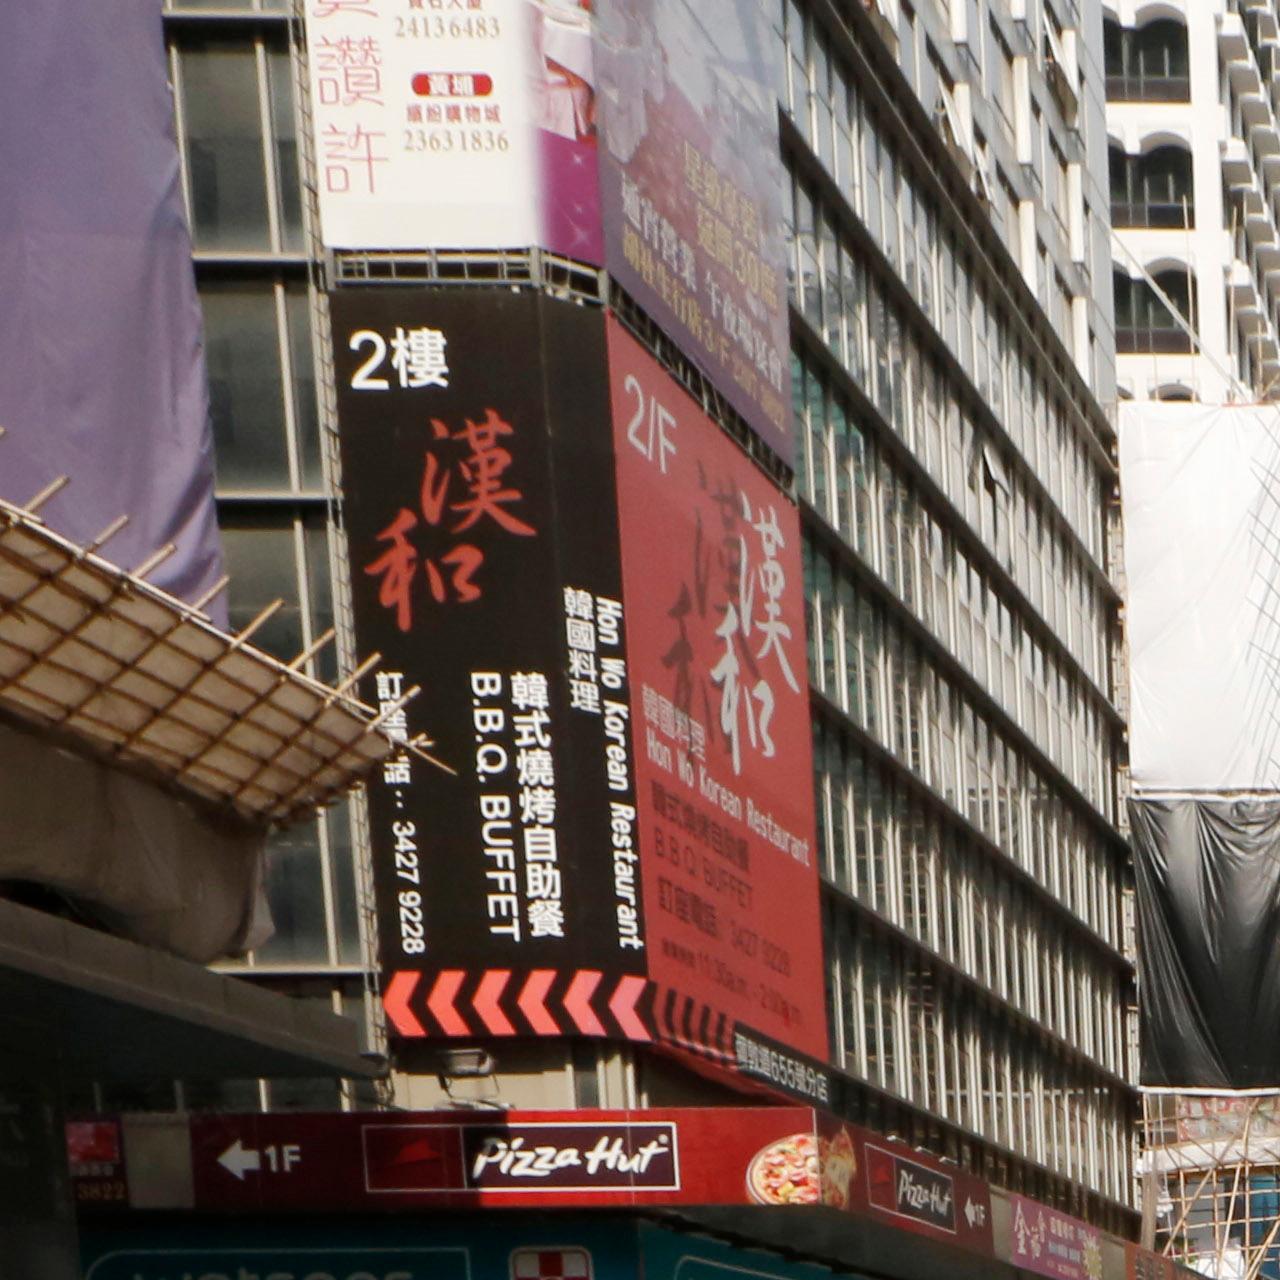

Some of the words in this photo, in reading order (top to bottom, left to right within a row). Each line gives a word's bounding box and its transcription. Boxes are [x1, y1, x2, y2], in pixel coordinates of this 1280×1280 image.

[349, 326, 450, 391] 2樓
[624, 374, 677, 474] 2/F
[362, 407, 537, 632] 漢和
[562, 585, 601, 715] 韓國料理
[596, 595, 623, 646] Hon
[600, 656, 625, 690] Wo
[470, 671, 509, 784] B.B.Q.
[601, 697, 631, 793] Korean
[510, 671, 566, 939] 韓式燒烤自助餐
[646, 725, 673, 775] Hon
[699, 764, 743, 821] Korean
[746, 796, 811, 868] Restaurant
[391, 820, 421, 886] 3427
[480, 794, 522, 943] BUFFET
[609, 801, 645, 951] Restaurant
[397, 889, 426, 955] 9228
[265, 1145, 301, 1173] 1F
[473, 1137, 582, 1178] Pizza
[585, 1136, 669, 1176] Hut
[899, 1169, 930, 1209] Pizza
[930, 1183, 952, 1217] Hut
